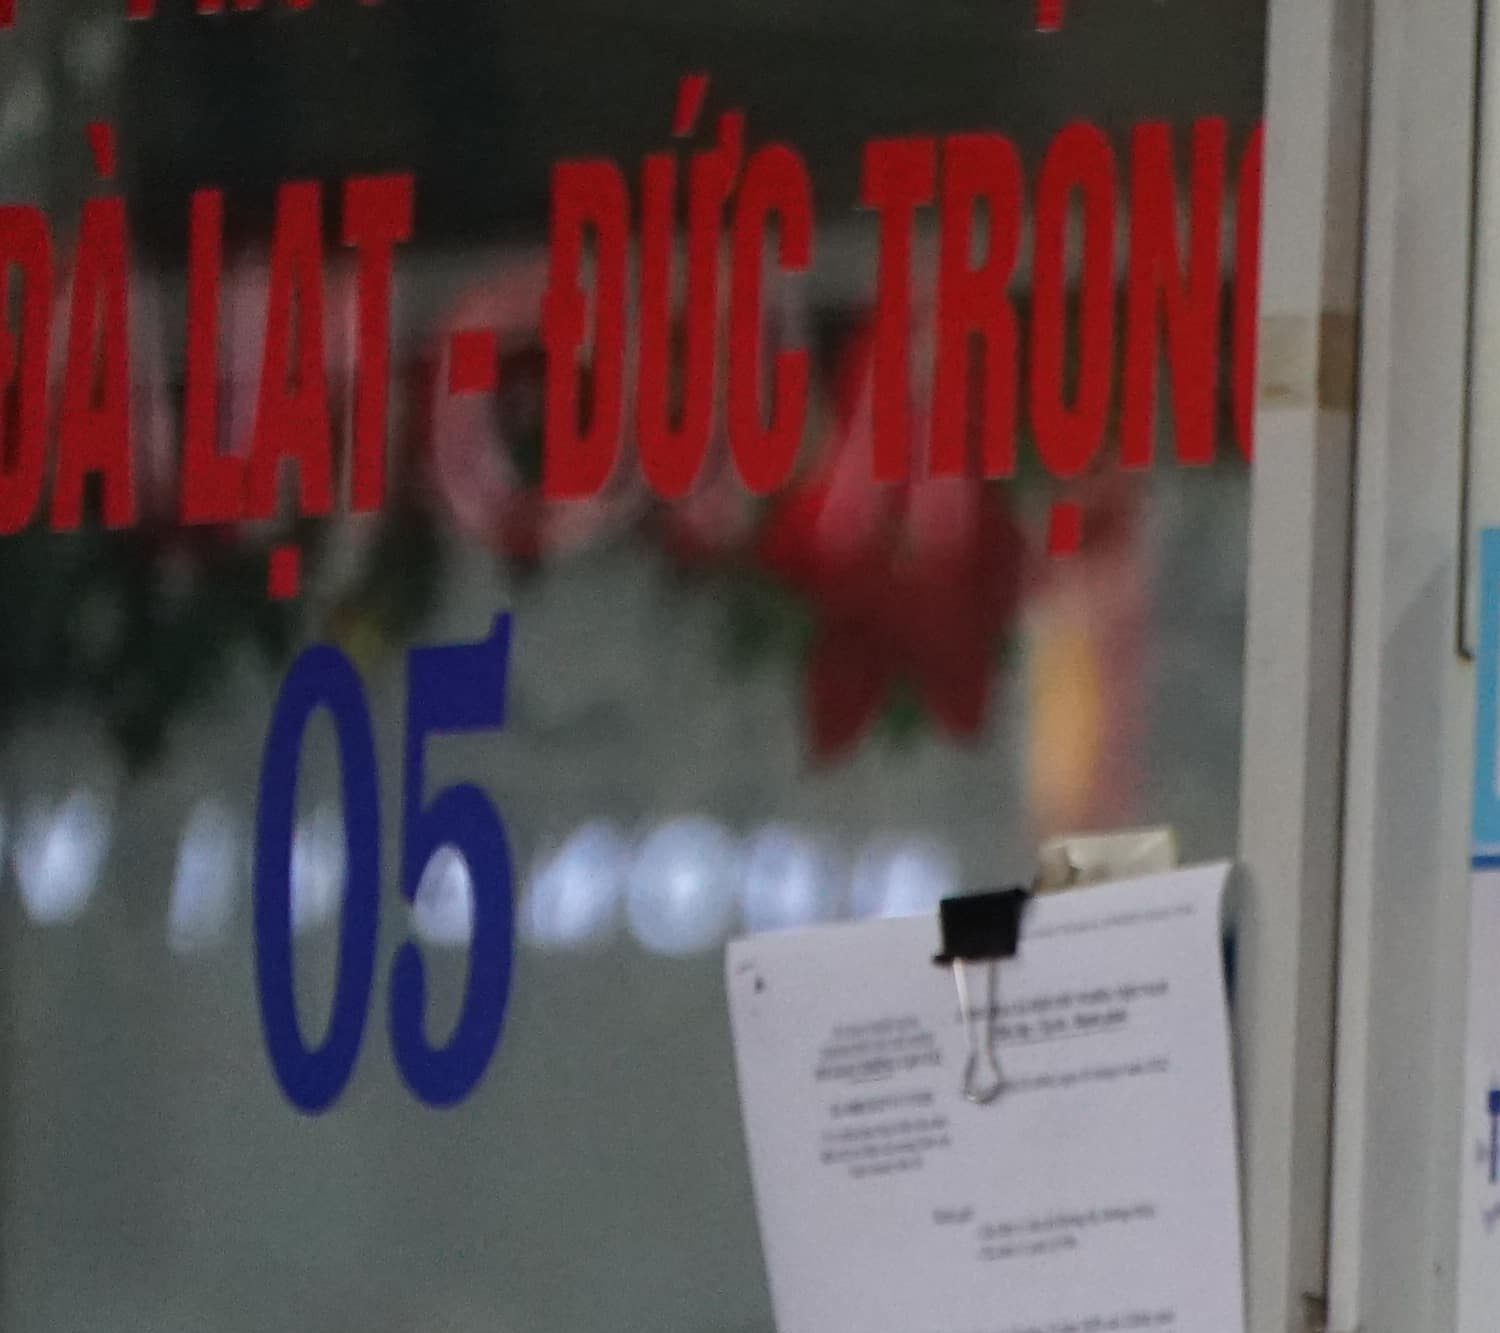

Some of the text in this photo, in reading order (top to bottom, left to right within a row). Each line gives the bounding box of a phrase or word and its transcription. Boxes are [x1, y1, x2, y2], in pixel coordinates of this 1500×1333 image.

[180, 172, 415, 600] LẠT
[543, 75, 814, 500] ĐỨC
[861, 115, 1265, 555] TRỌN
[253, 611, 517, 1117] 05
